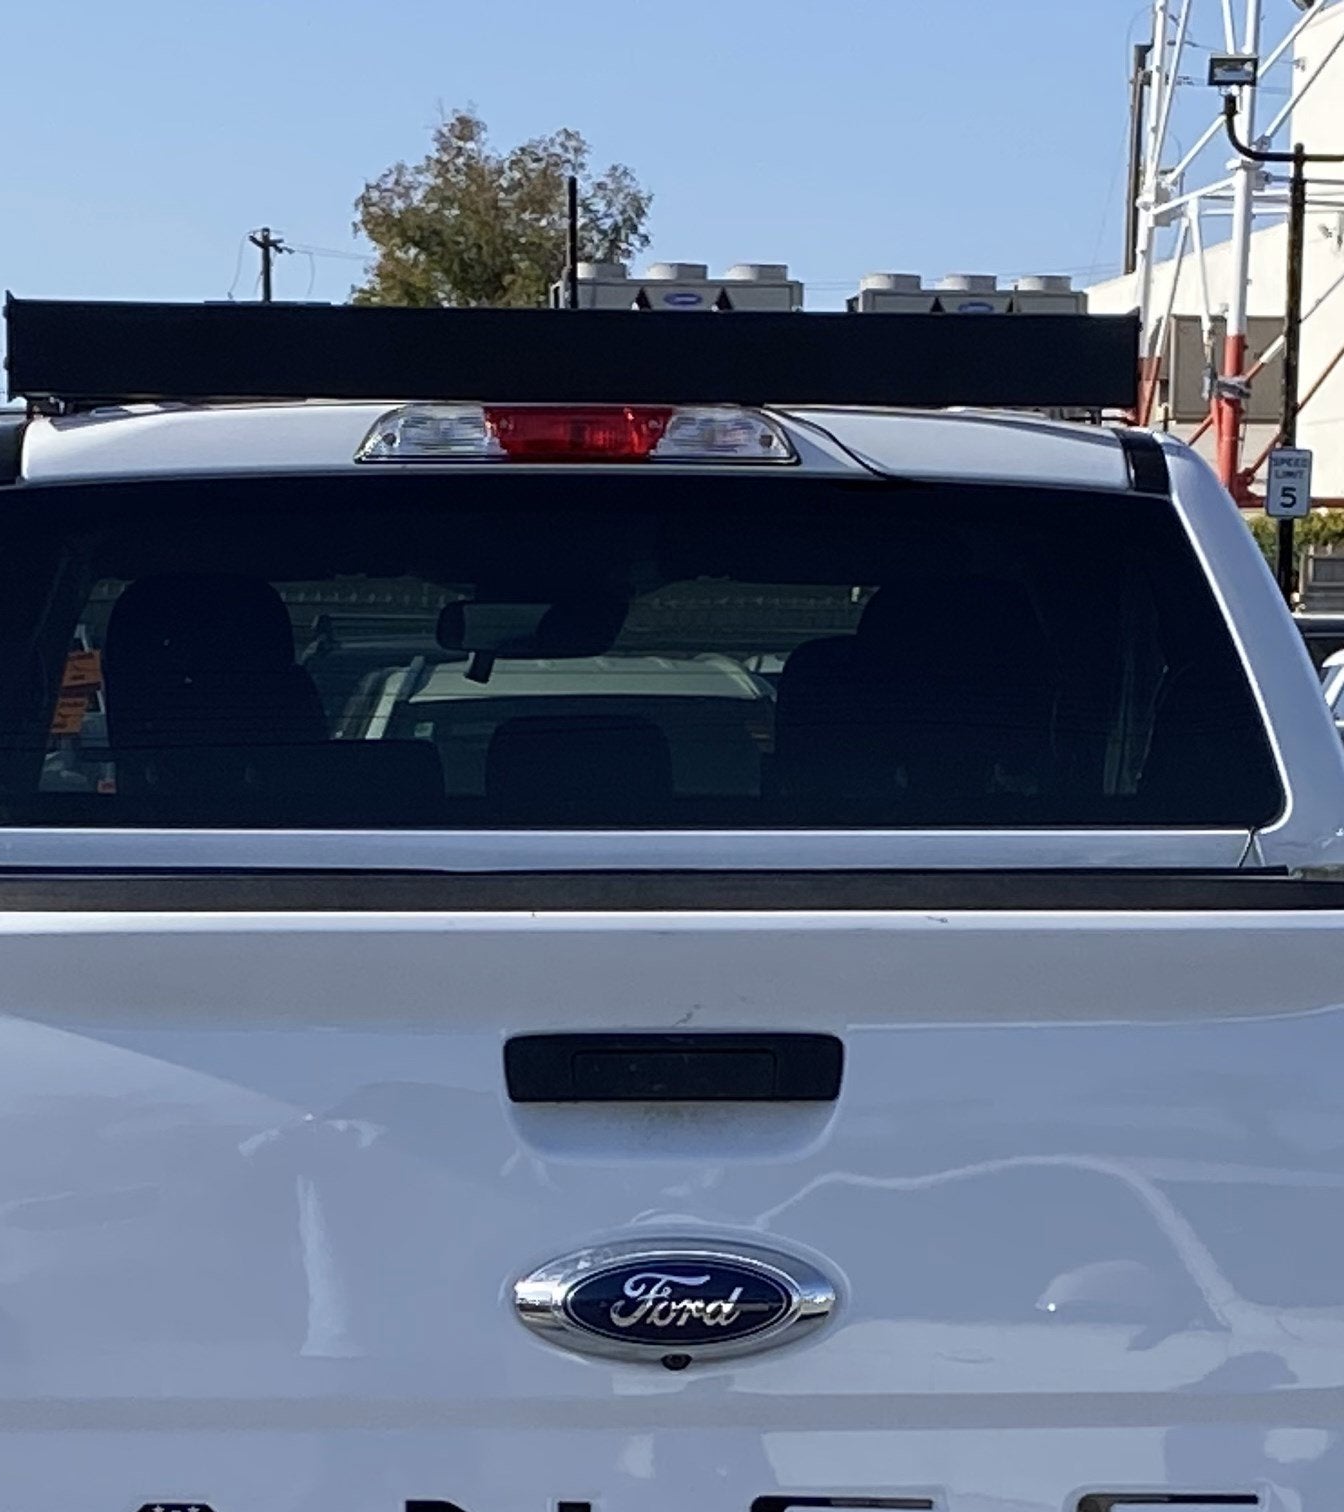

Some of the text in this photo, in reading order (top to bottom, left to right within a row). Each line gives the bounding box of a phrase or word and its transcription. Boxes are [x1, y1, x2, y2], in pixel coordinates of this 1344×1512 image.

[1272, 457, 1308, 468] SPEED
[1275, 469, 1304, 480] LIMIT
[1280, 486, 1297, 508] 5
[608, 1272, 744, 1328] Ford
